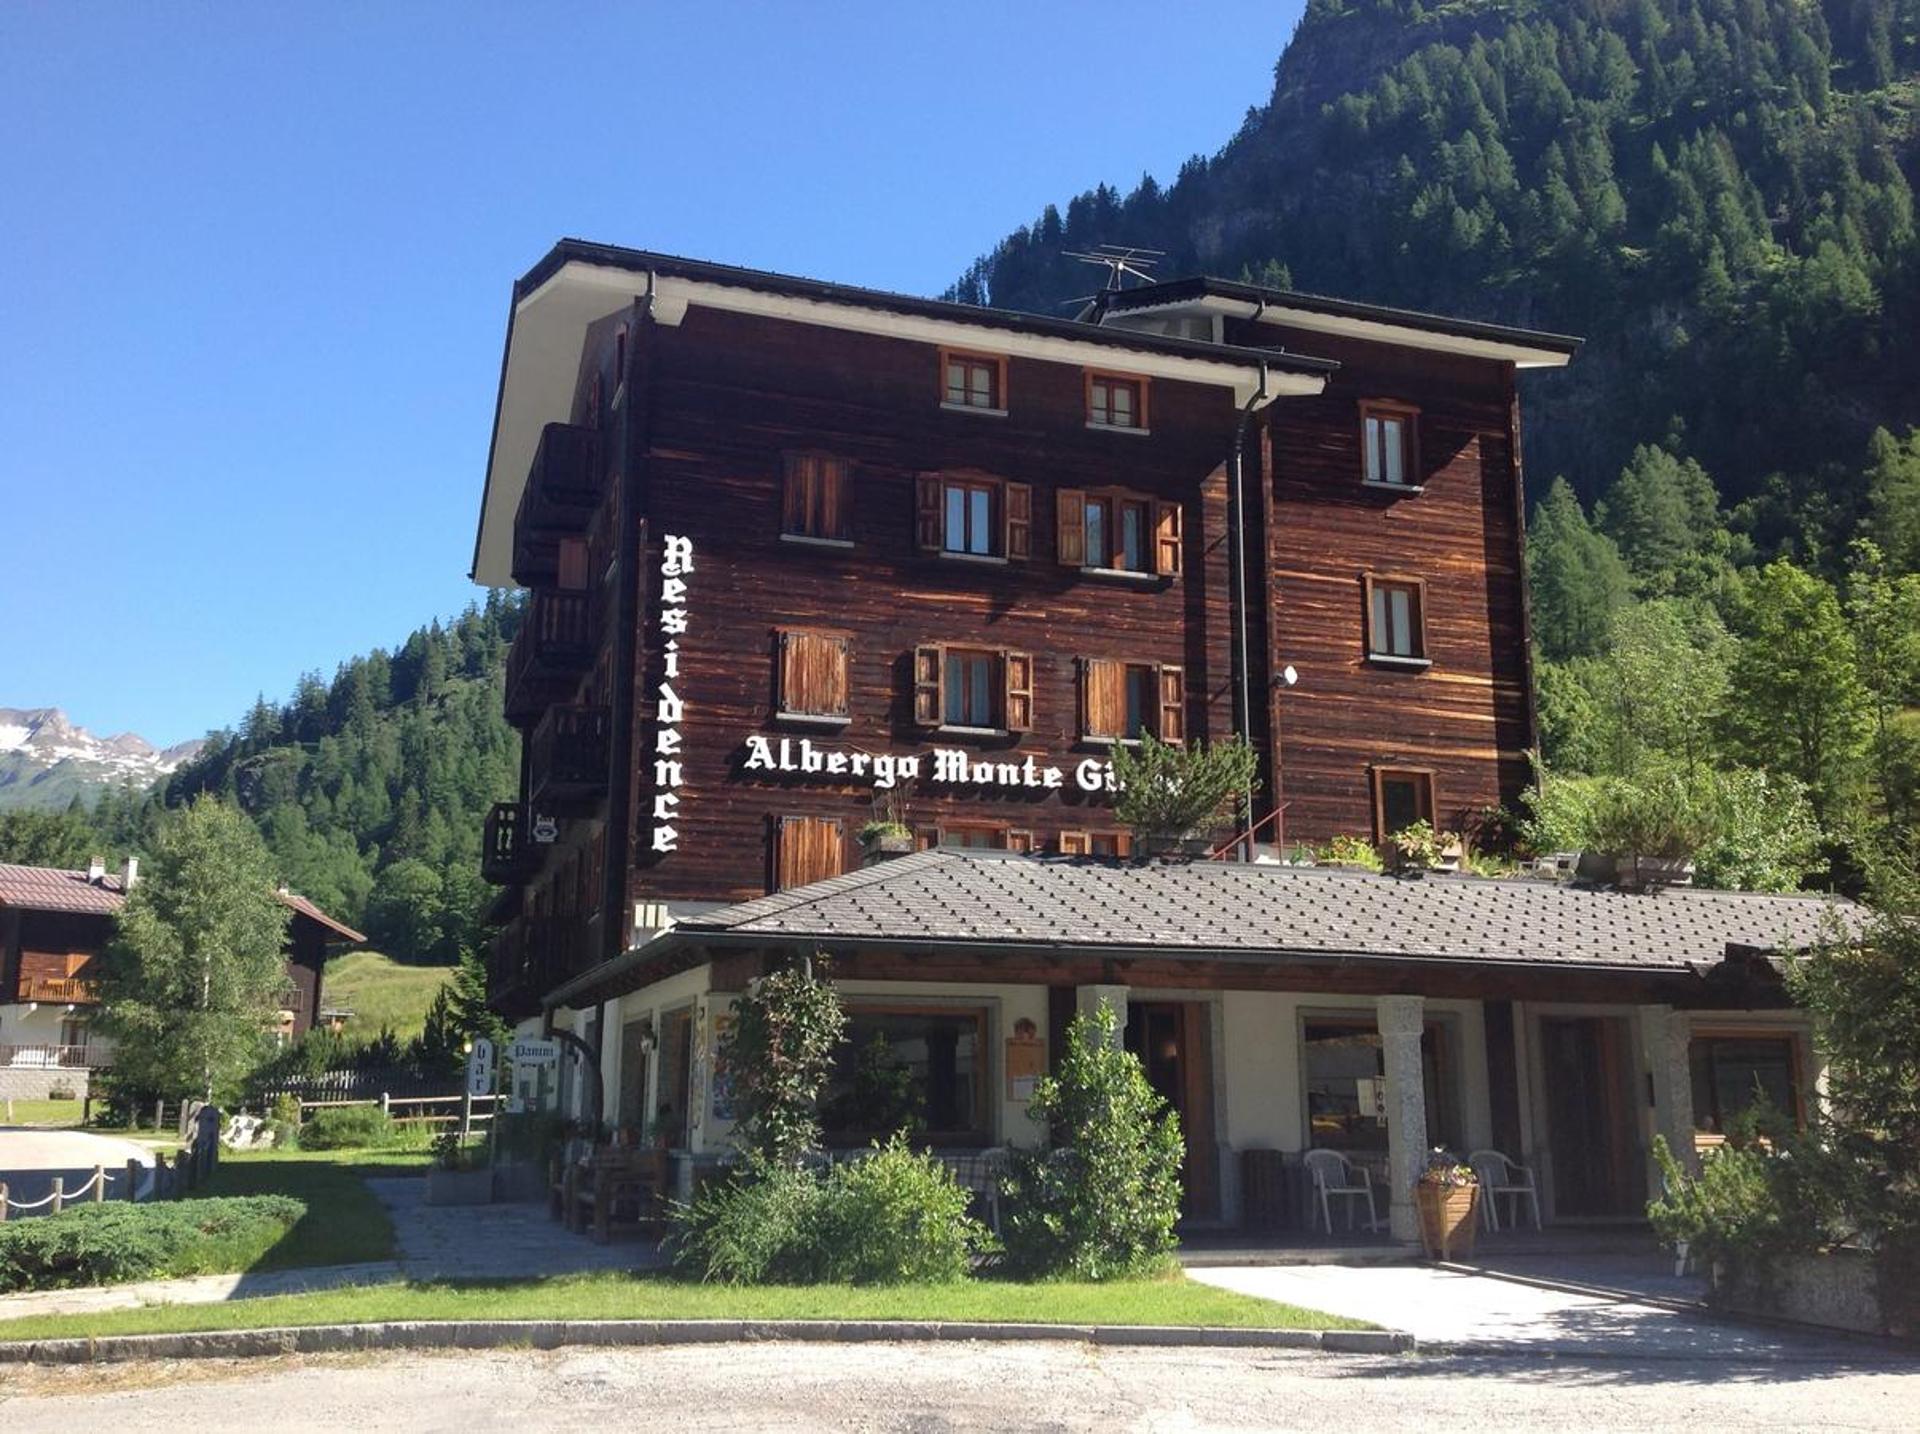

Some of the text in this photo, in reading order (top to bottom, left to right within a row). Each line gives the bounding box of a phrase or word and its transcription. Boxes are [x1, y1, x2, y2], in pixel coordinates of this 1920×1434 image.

[651, 534, 694, 852] Residence
[743, 735, 919, 789] Albergo
[932, 748, 1064, 788] Monte
[475, 1044, 486, 1091] bar
